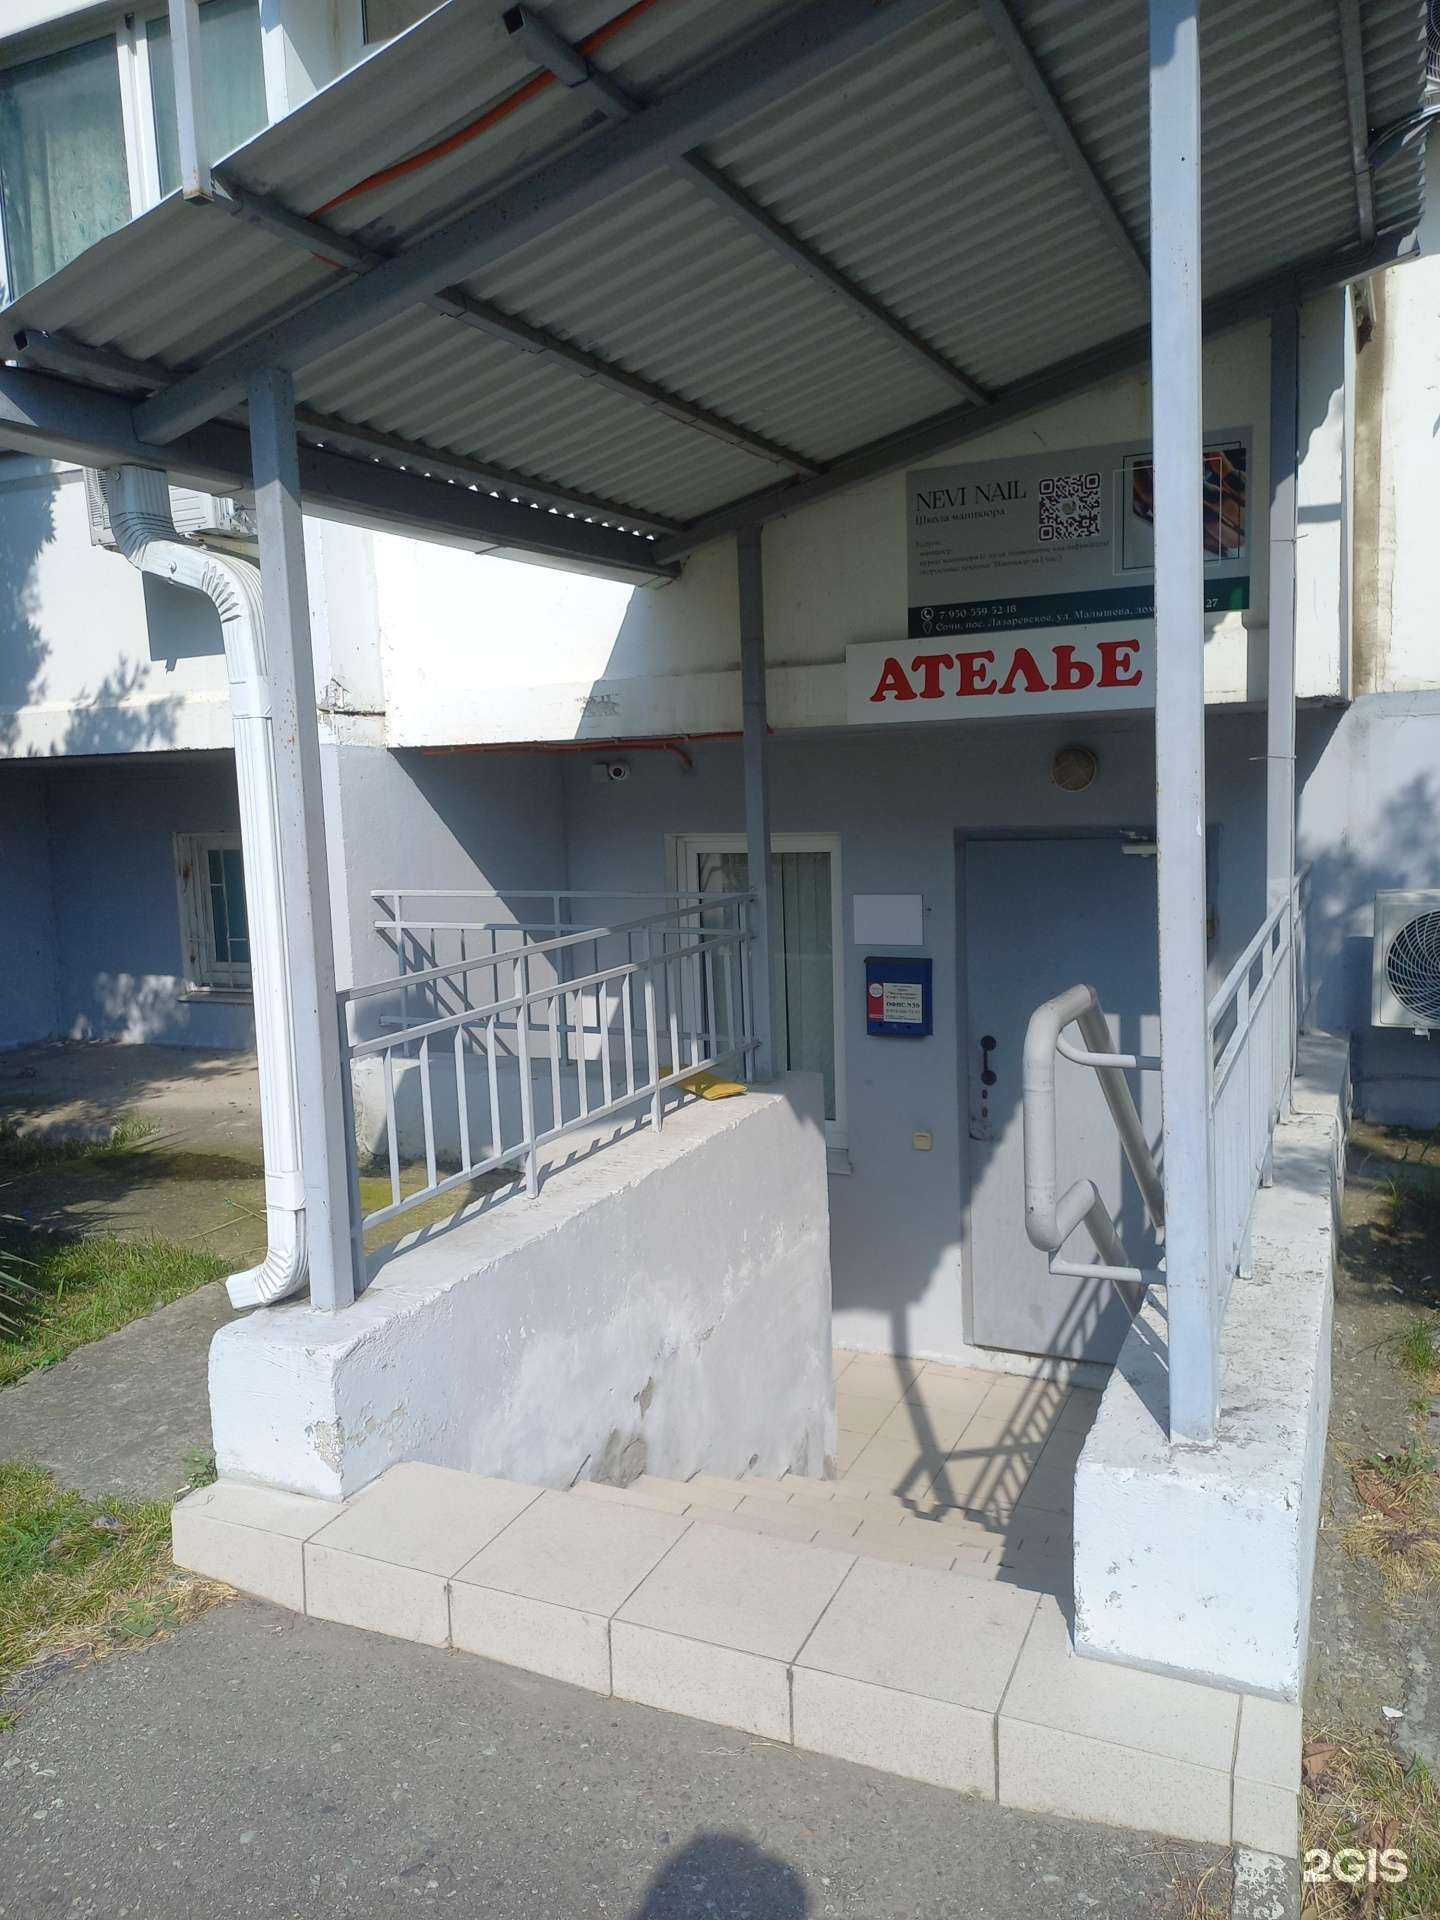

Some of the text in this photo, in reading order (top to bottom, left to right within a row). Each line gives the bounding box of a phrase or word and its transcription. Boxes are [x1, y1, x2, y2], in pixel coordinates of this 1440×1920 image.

[915, 480, 1026, 512] NEVI NAIL
[869, 639, 1143, 702] АТЕЛЬЕ
